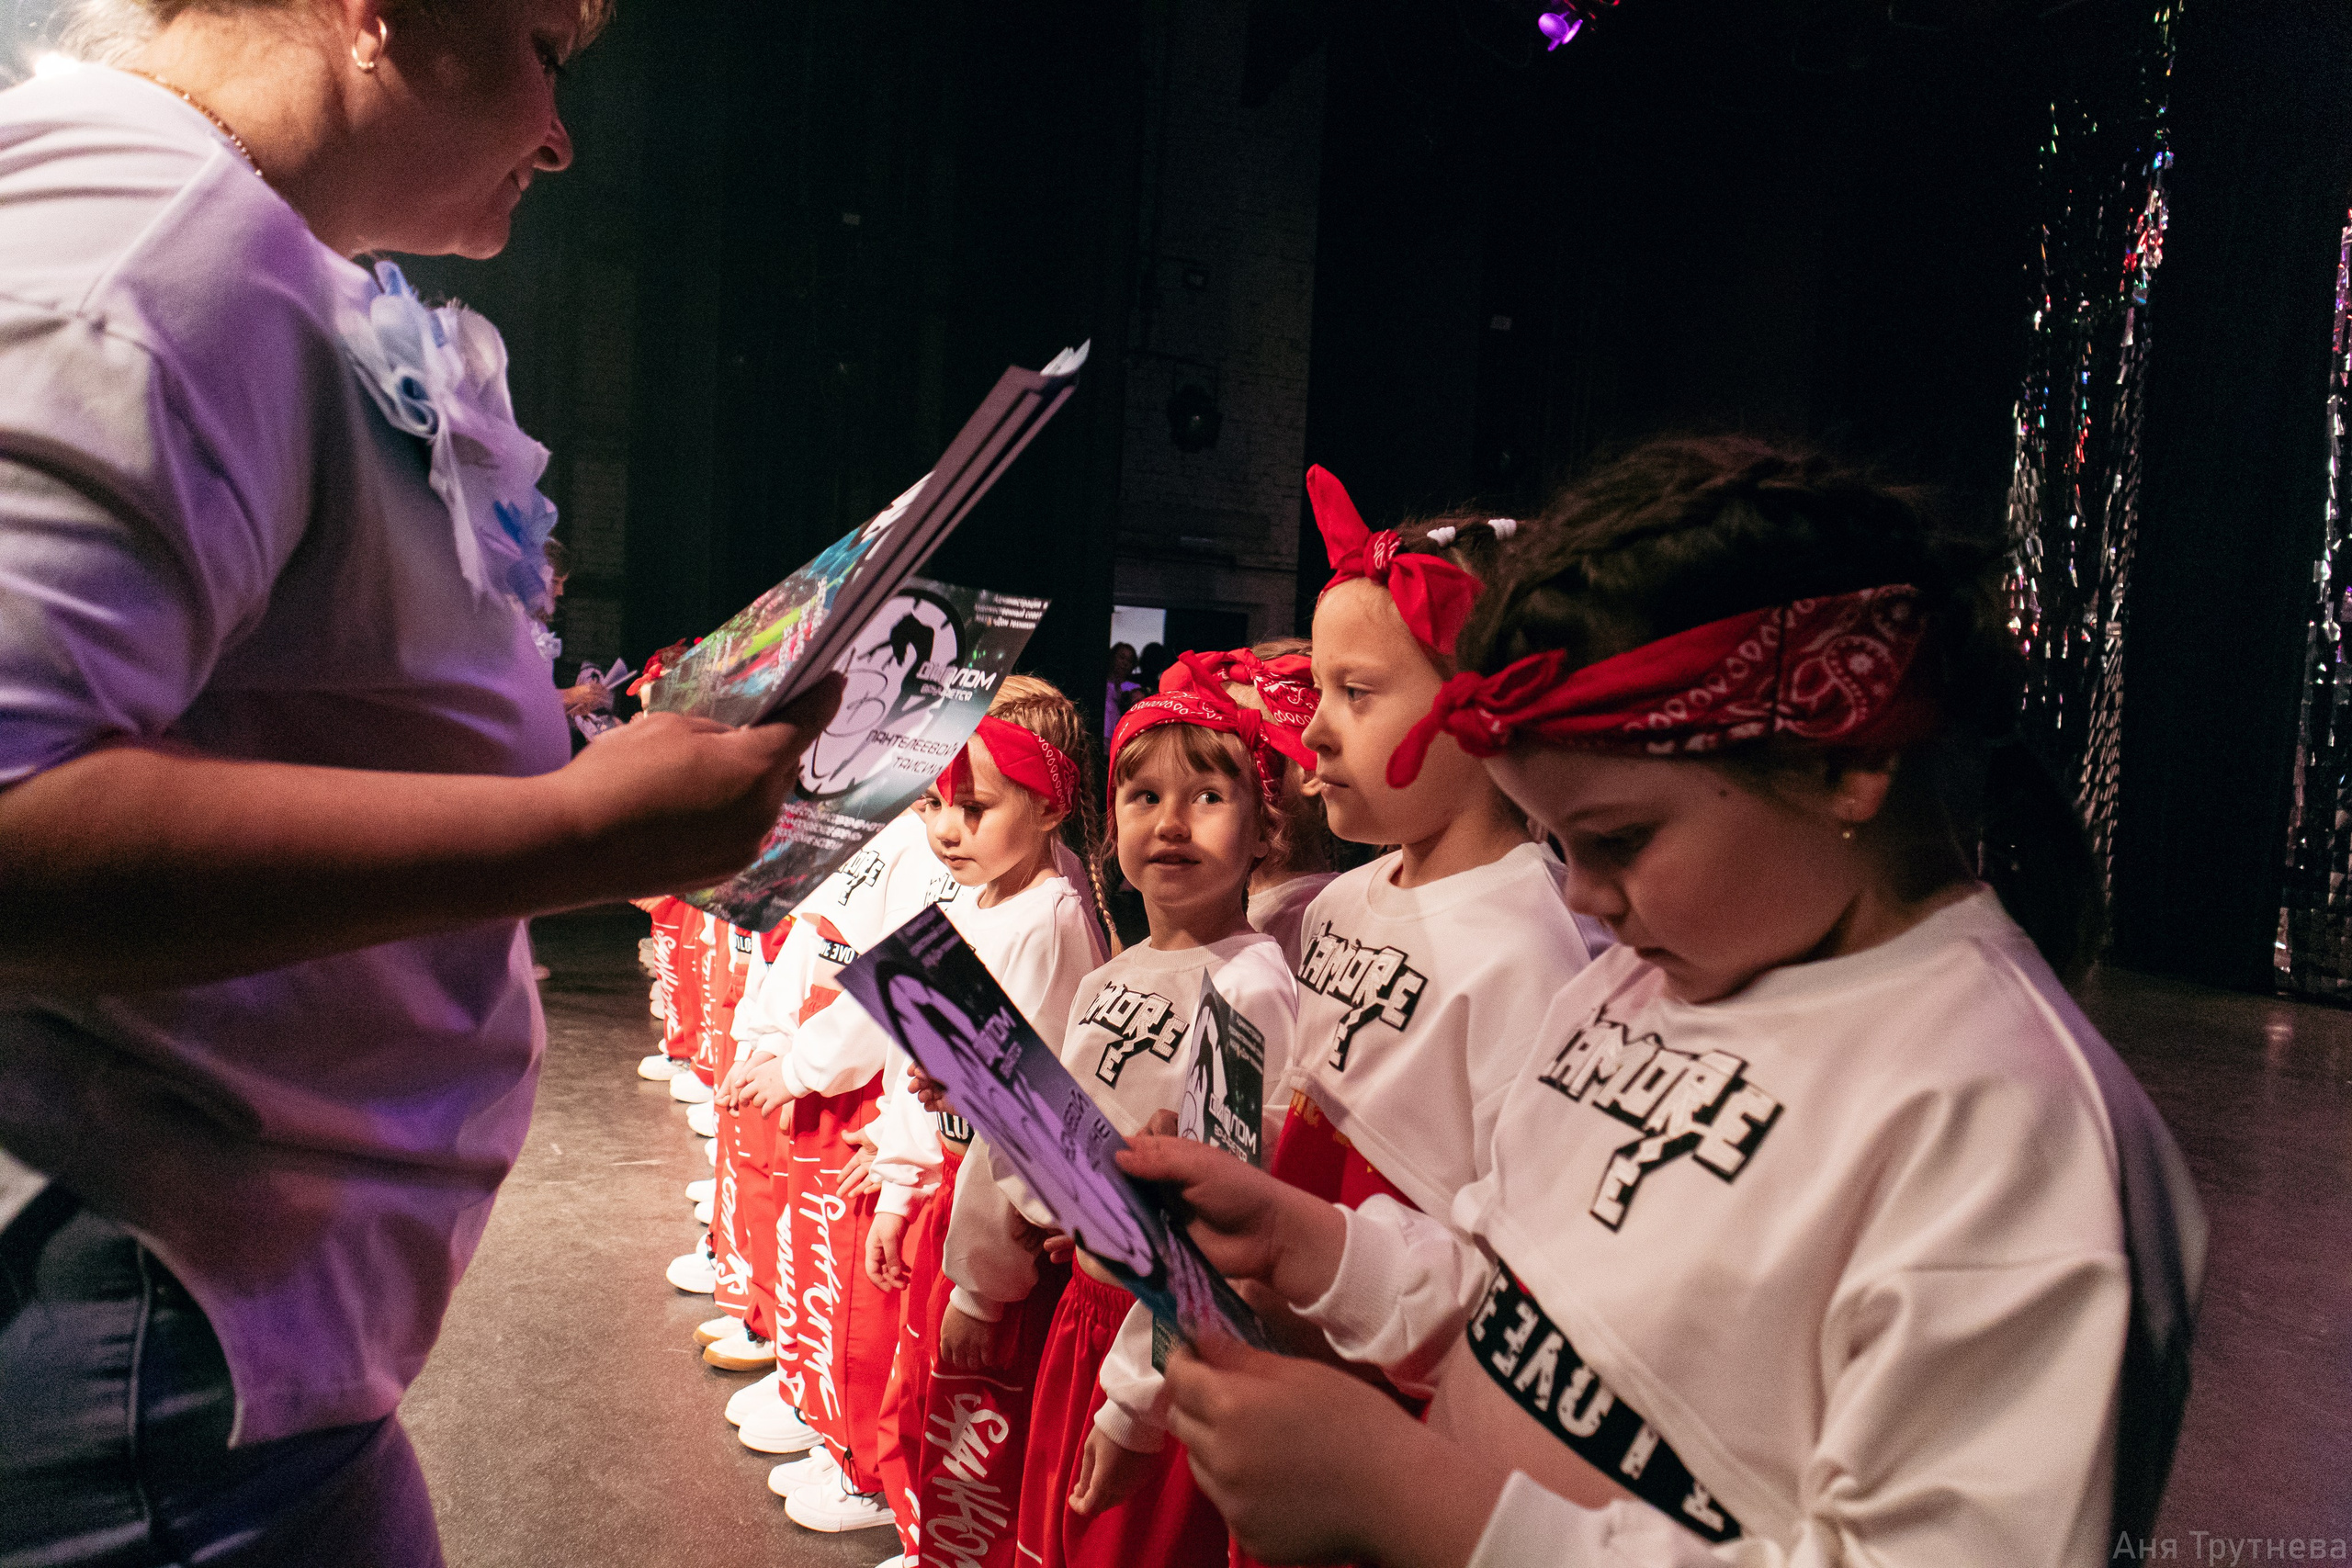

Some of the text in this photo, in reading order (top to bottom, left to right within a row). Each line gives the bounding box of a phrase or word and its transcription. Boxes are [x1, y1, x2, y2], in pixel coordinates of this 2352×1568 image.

[916, 660, 997, 691] ДИПЛОМ
[866, 728, 958, 758] ПАНТЕЛЕЕВОЙ
[892, 755, 943, 776] ТАИСИИ
[831, 942, 855, 964] OVE
[1208, 1092, 1258, 1155] ДИПЛОМ
